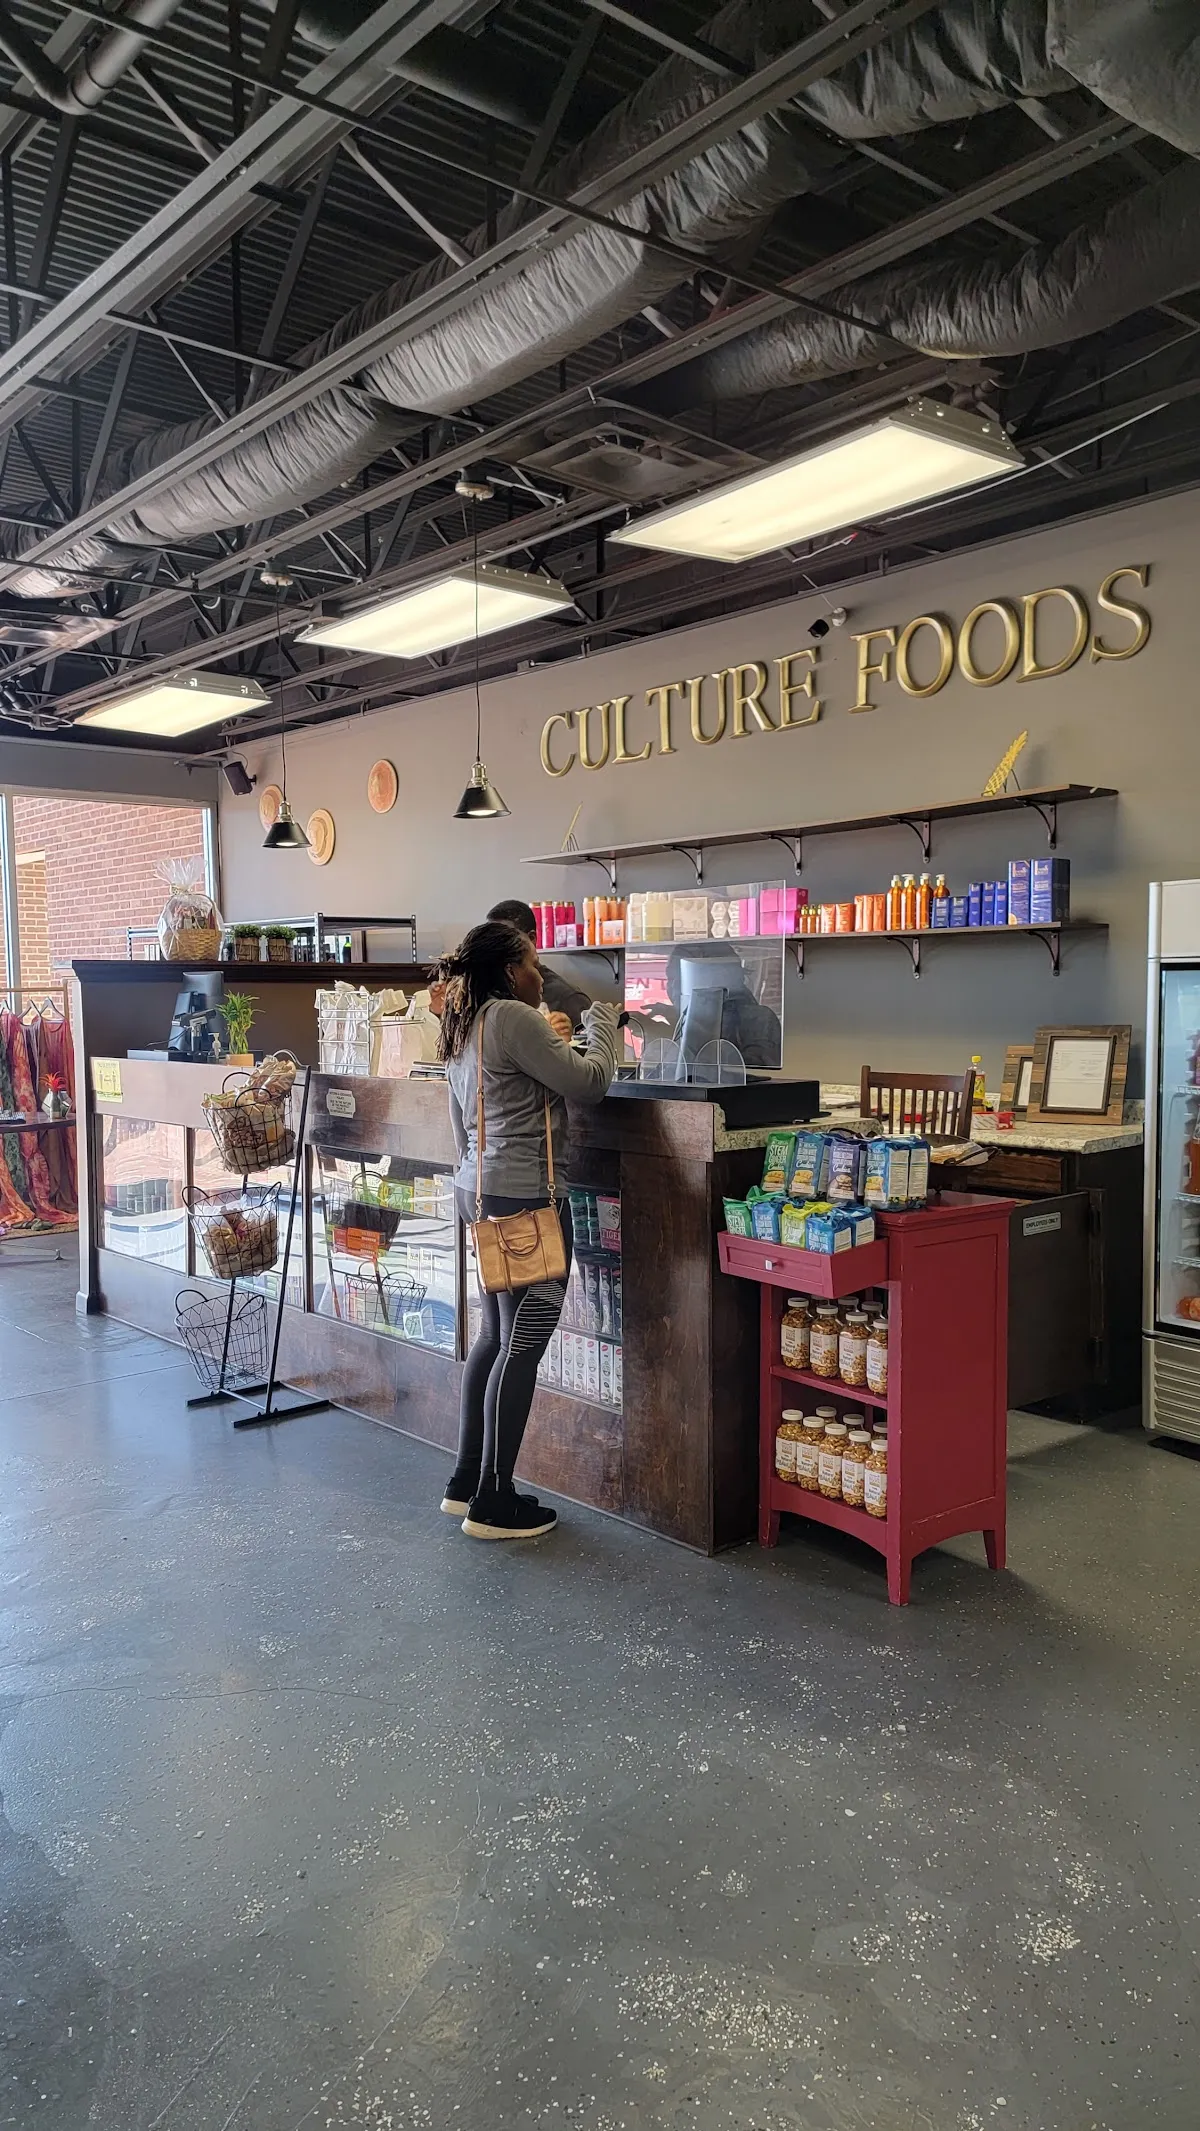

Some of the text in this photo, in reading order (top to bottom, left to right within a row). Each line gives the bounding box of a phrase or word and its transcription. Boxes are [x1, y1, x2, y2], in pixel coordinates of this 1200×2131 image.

[540, 563, 1151, 778] CULTURE FOODS
[770, 1144, 789, 1156] STEM
[832, 1163, 852, 1173] Cookies
[727, 1214, 746, 1227] STEM
